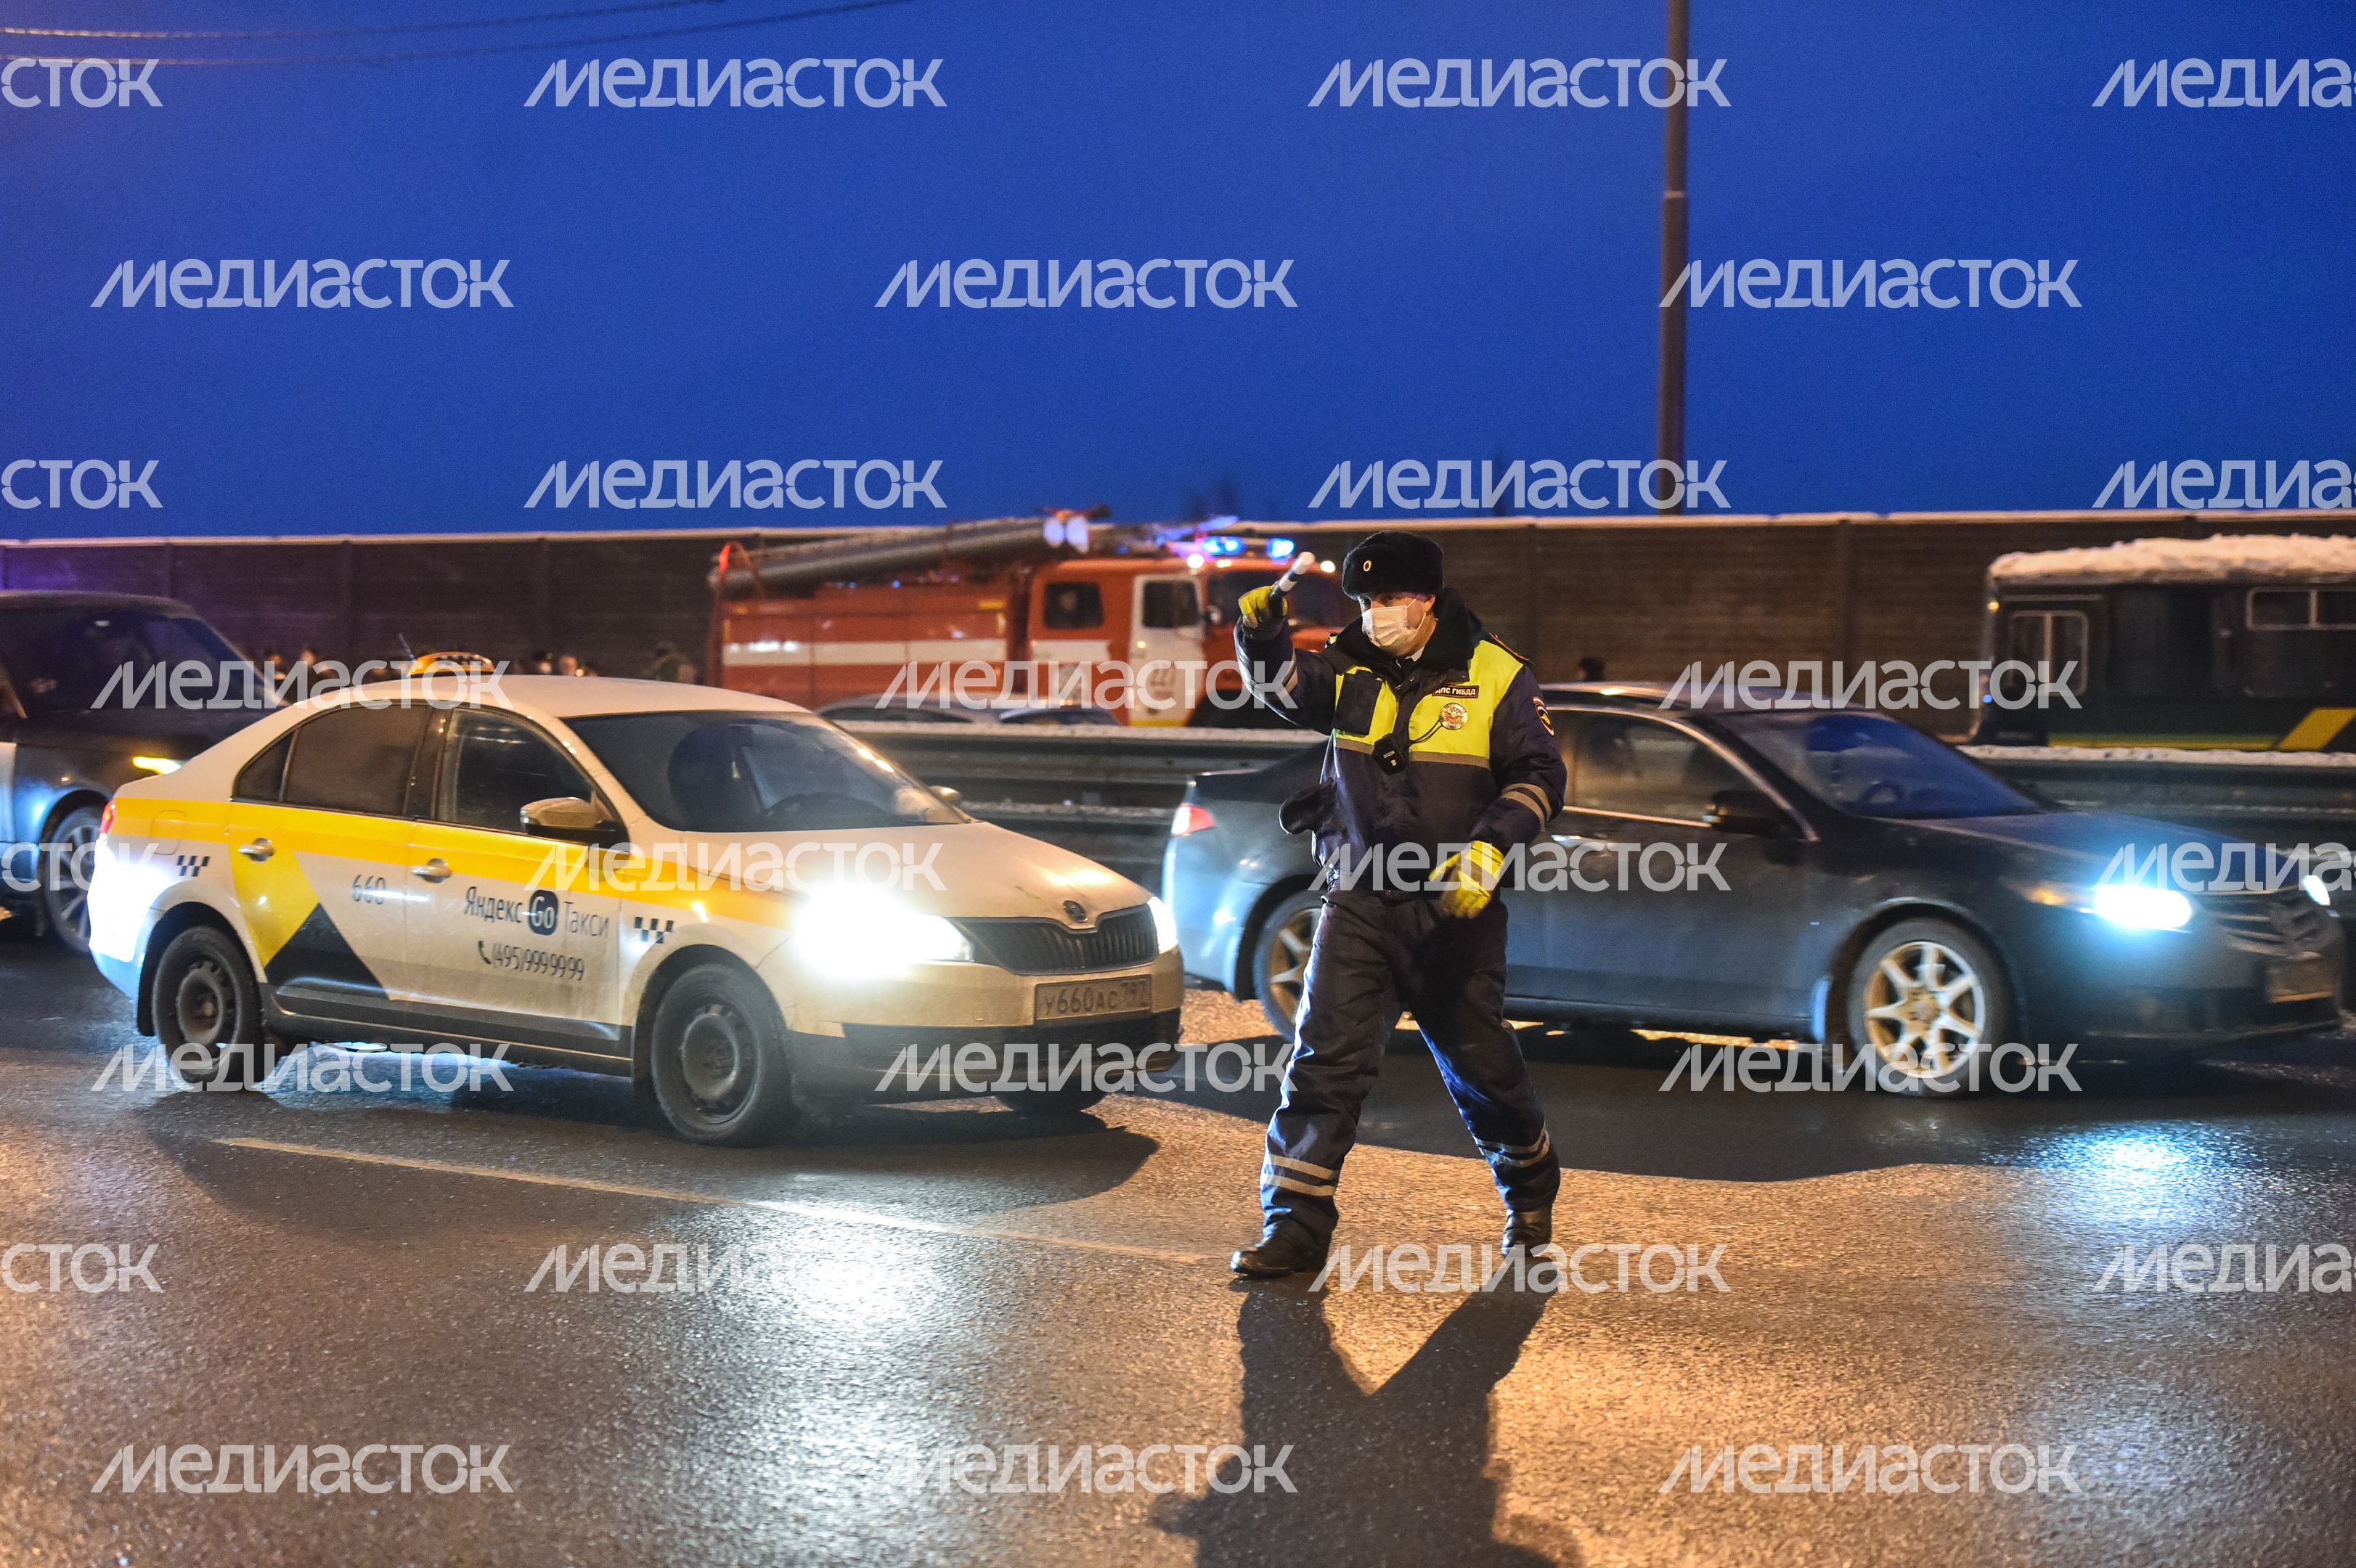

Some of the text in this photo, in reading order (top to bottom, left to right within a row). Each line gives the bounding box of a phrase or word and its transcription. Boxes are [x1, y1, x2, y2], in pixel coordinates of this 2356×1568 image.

[352, 874, 386, 905] 660
[464, 886, 609, 938] Яндекс Go Такси
